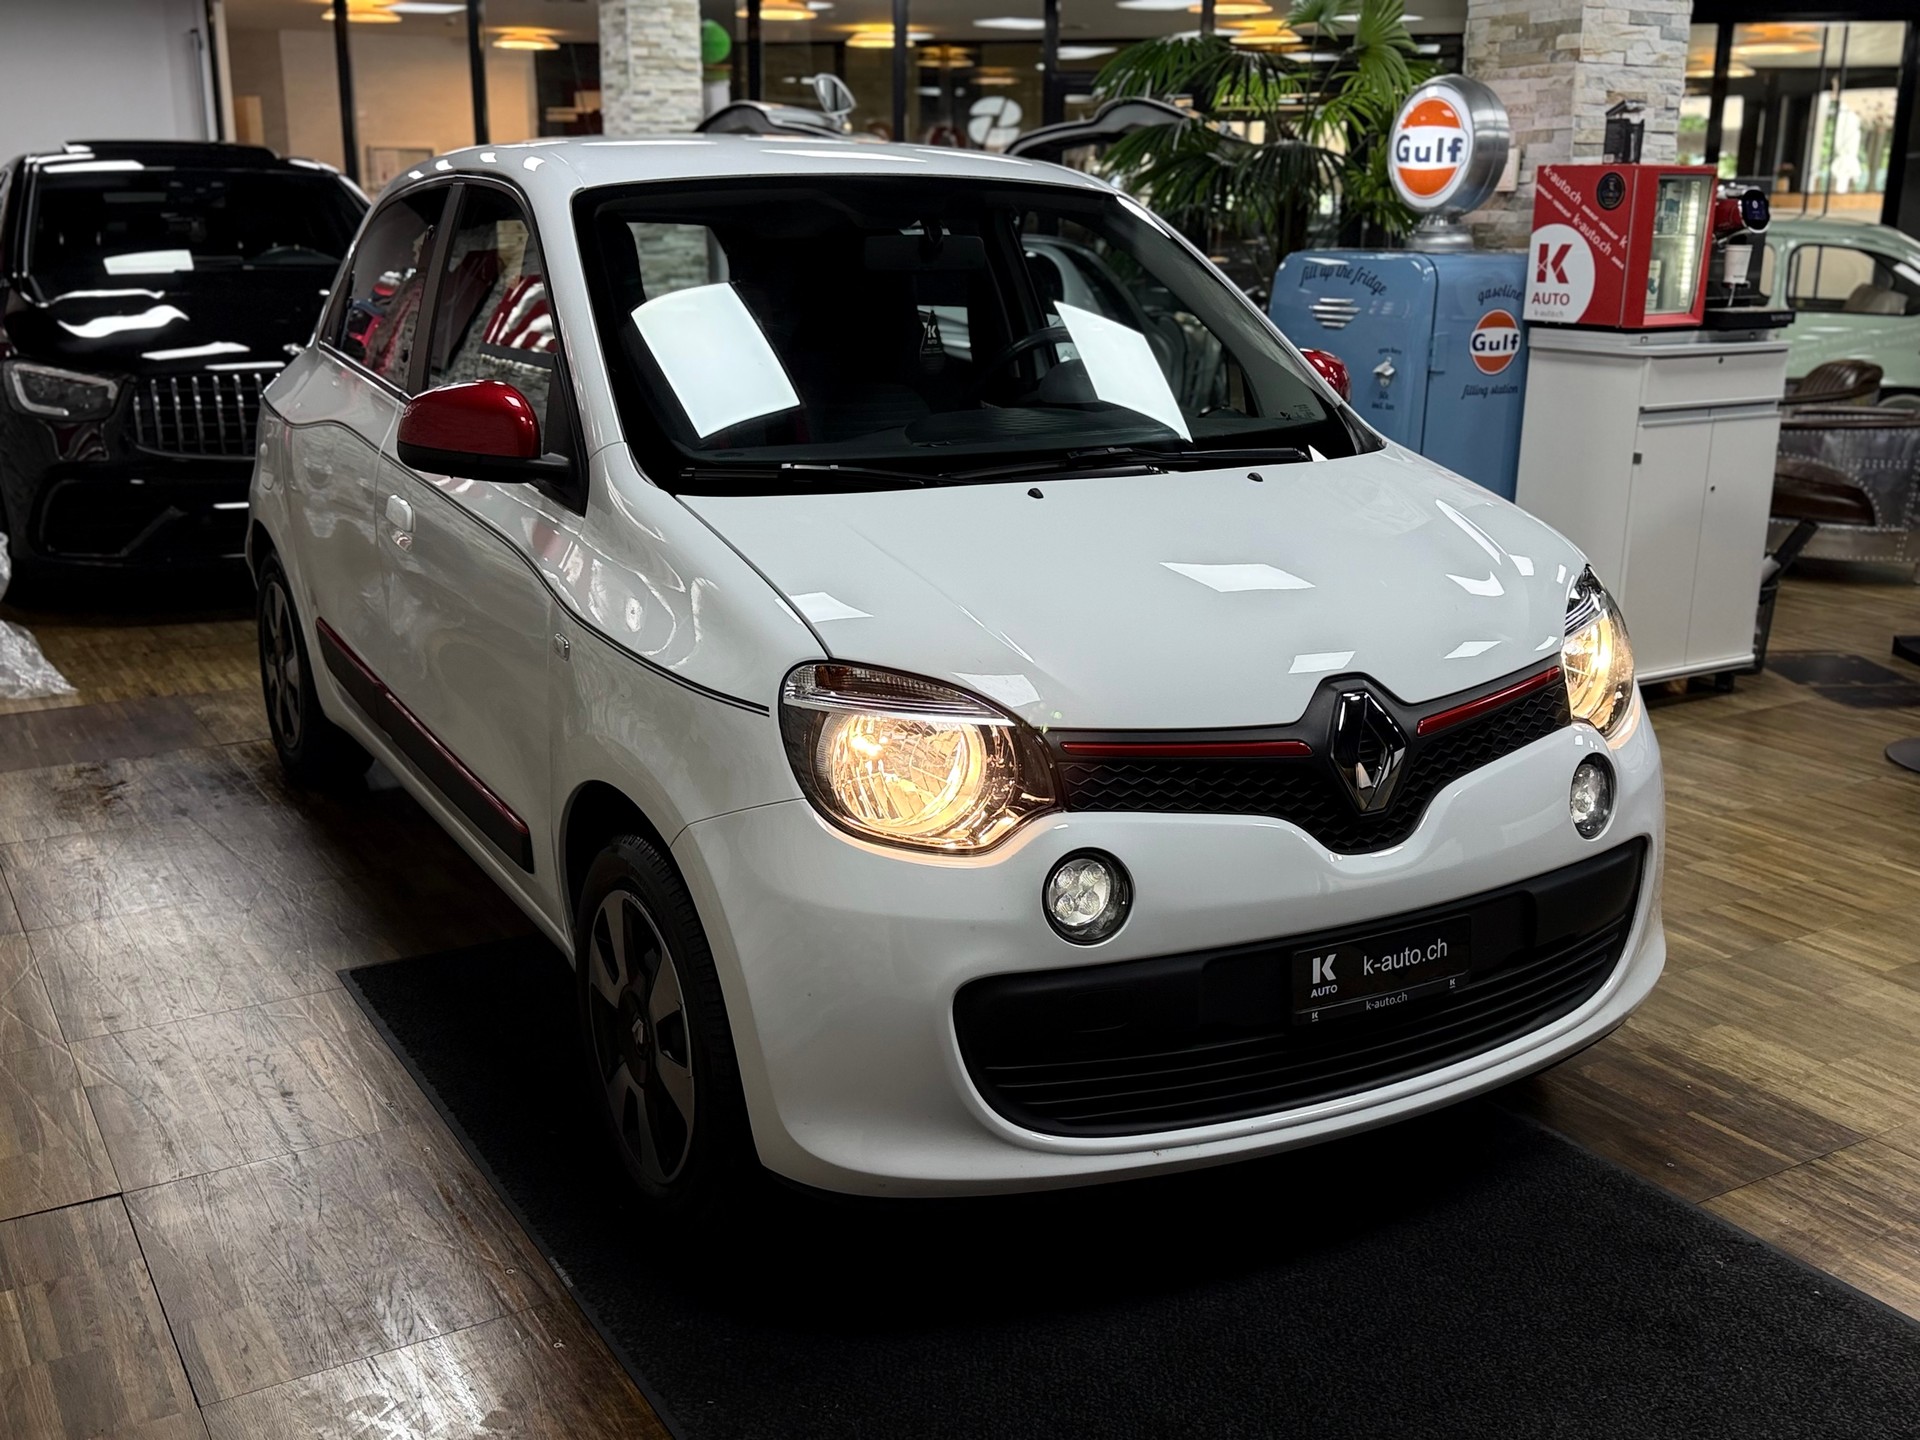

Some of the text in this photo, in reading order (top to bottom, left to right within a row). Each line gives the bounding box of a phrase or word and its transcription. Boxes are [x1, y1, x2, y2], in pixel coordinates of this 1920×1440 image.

[1396, 134, 1463, 163] Gulf
[1543, 166, 1582, 205] k-auto.ch
[1572, 213, 1612, 256] k-auto.ch
[1536, 244, 1573, 284] K
[1299, 264, 1387, 296] fill up the fridge
[1478, 284, 1523, 306] gasoline
[1532, 291, 1570, 306] AUTO
[1472, 333, 1519, 352] Gulf
[1461, 384, 1519, 400] filling station
[1312, 953, 1337, 985] K
[1363, 938, 1448, 976] k-auto.ch
[1310, 984, 1338, 999] AUTO
[1365, 992, 1408, 1011] k-auto.ch
